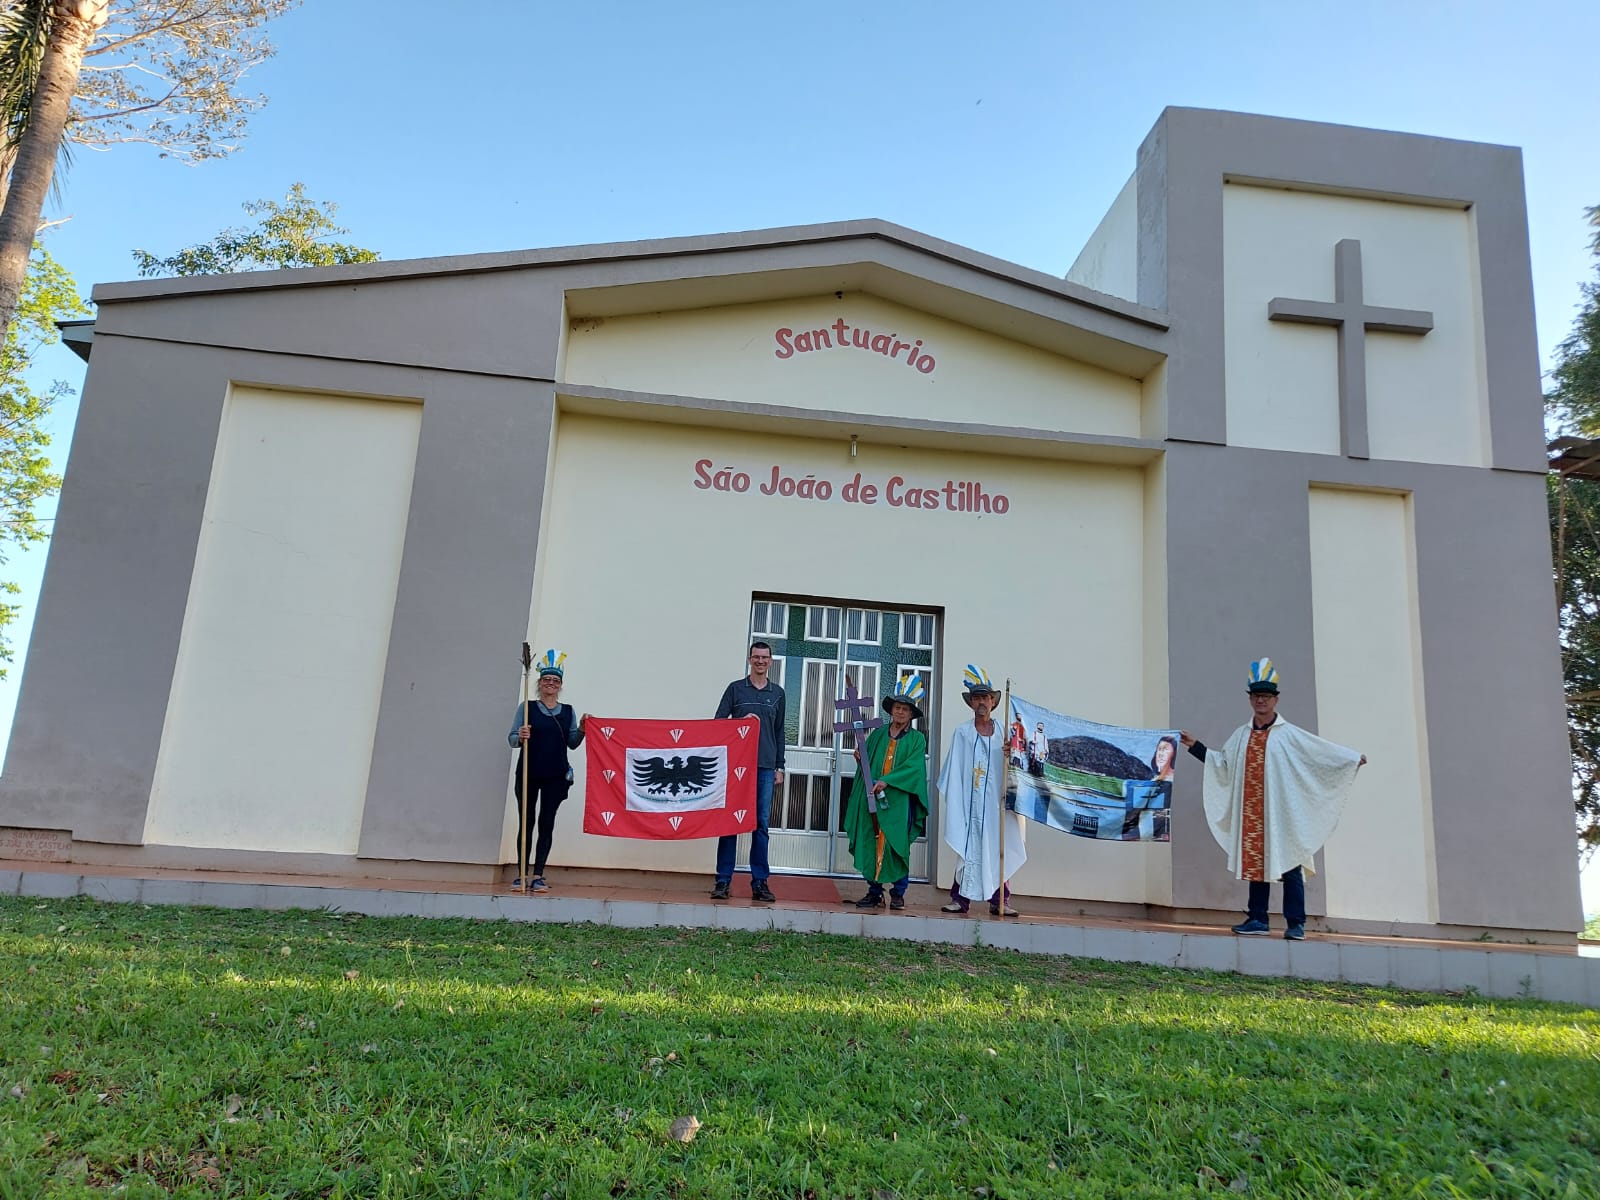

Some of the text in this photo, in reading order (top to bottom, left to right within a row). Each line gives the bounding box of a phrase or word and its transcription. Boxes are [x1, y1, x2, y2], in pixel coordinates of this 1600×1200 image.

[774, 318, 936, 373] Santuário
[694, 458, 1009, 514] São João de Castilho
